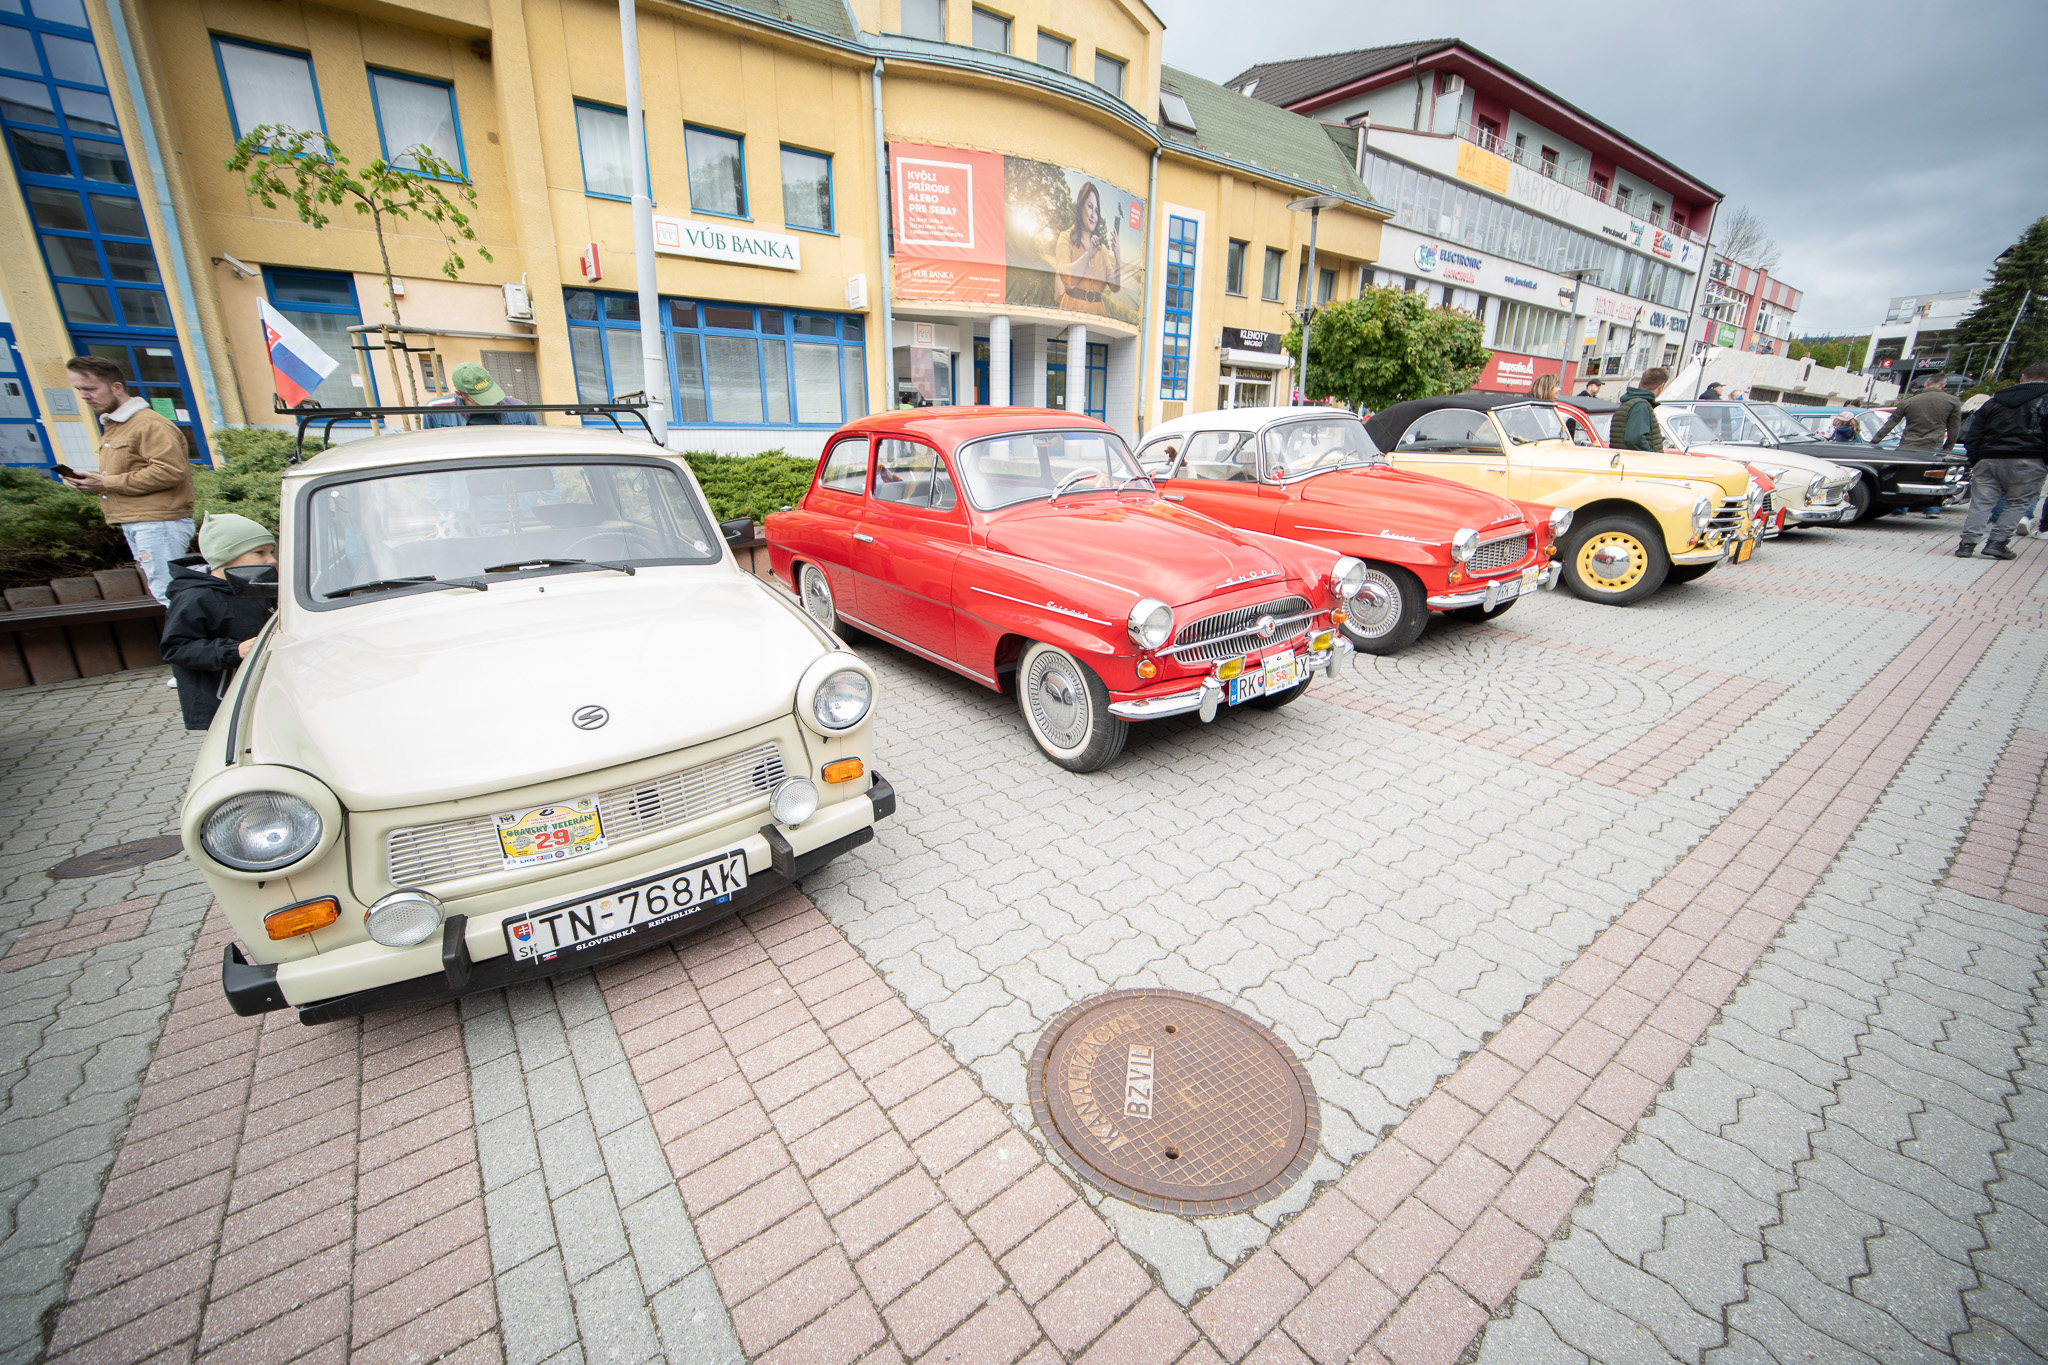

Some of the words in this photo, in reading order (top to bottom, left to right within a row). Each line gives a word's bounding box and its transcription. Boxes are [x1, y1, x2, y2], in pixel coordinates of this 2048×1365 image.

[907, 169, 937, 182] KVÔLI
[907, 181, 951, 194] PRÍRODE
[908, 192, 939, 203] ALEBO
[908, 203, 927, 213] PRE
[928, 204, 957, 216] SEBA?
[685, 226, 726, 251] VÚB
[732, 234, 794, 260] BANKA
[1439, 248, 1482, 270] ELECTRONIC
[912, 268, 928, 278] VÚB
[929, 270, 954, 279] BANKA
[1594, 296, 1616, 317] TEXTIL
[1669, 316, 1687, 333] TEXTIL
[1240, 329, 1269, 342] KLENOTY
[1236, 368, 1272, 379] ZLATNICTVO
[1275, 669, 1287, 682] 58
[1239, 674, 1257, 700] RK
[534, 828, 571, 850] 29
[538, 858, 742, 948] TN-768AK
[576, 926, 637, 951] SLOVENSKÁ
[647, 905, 702, 929] REPUBLIKA
[1126, 1048, 1152, 1116] BZVIL
